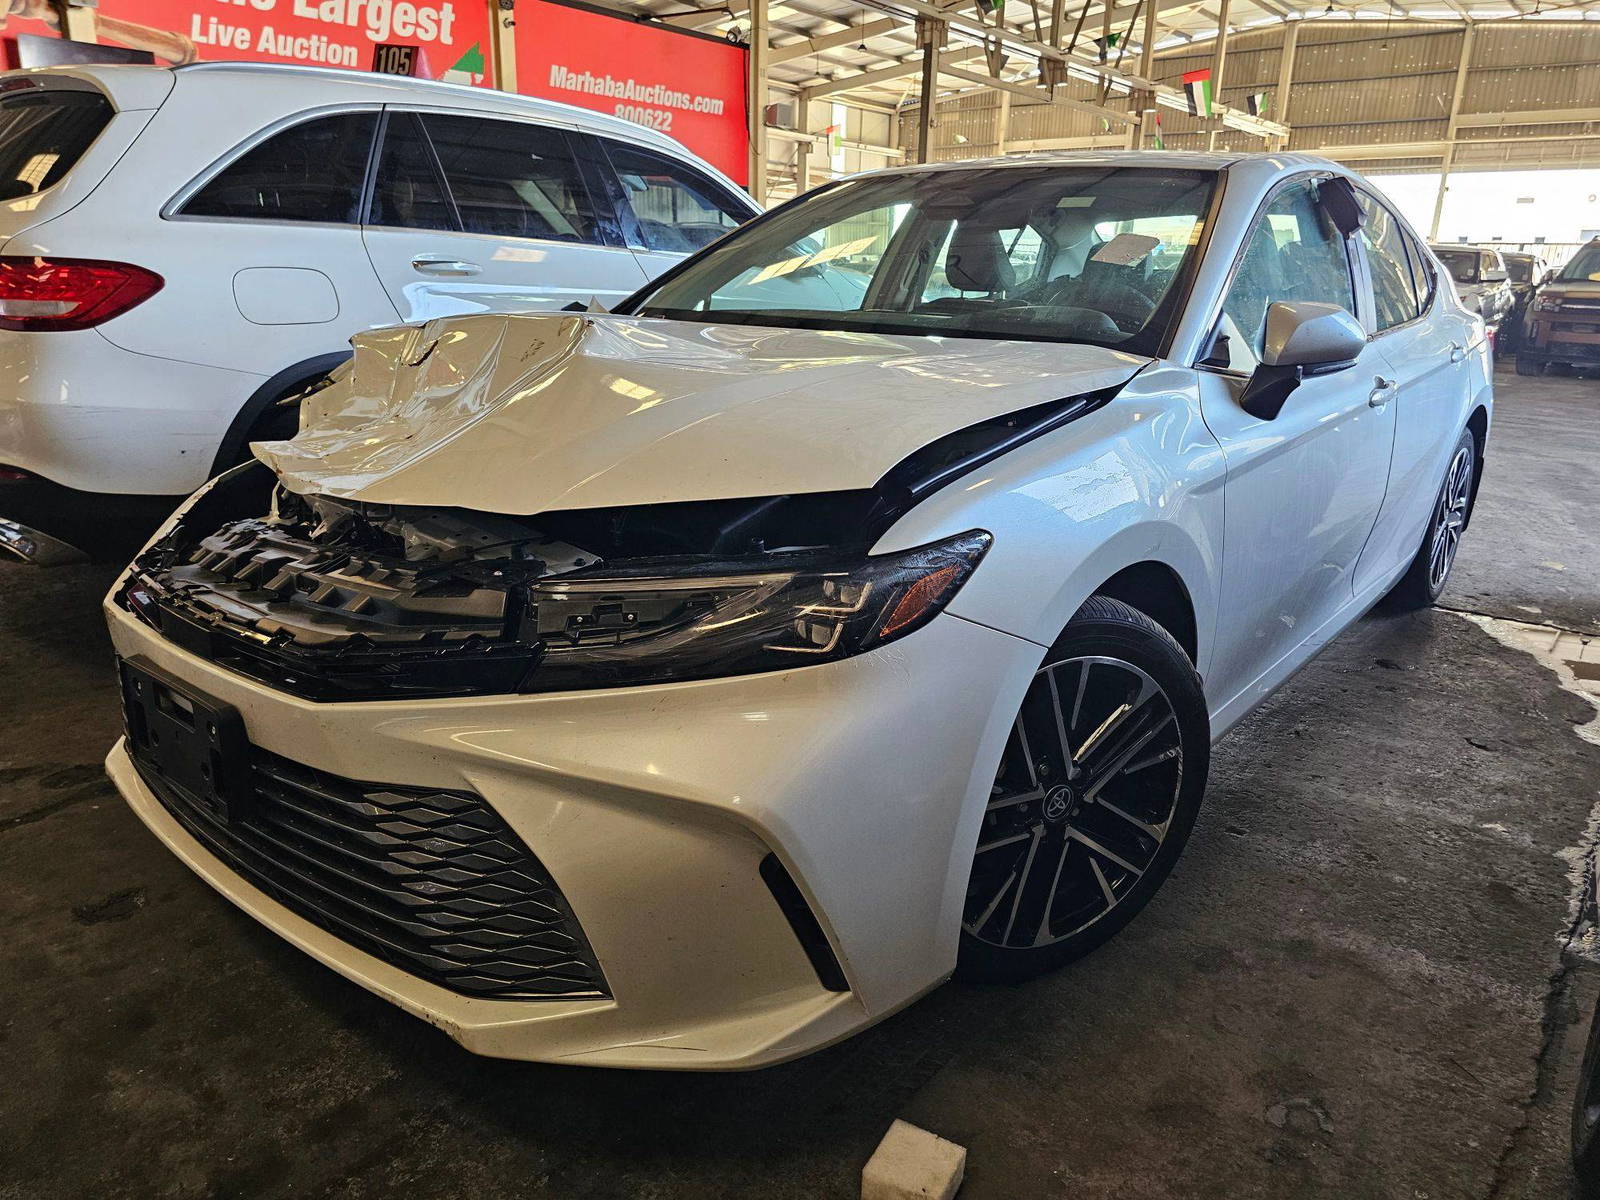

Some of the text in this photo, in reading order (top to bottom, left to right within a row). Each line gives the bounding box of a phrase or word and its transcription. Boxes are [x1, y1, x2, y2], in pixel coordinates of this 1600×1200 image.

[191, 14, 358, 66] Live Auction
[378, 47, 412, 75] 105
[550, 64, 724, 116] MarhabaAuctions.com
[614, 103, 672, 132] 800622
